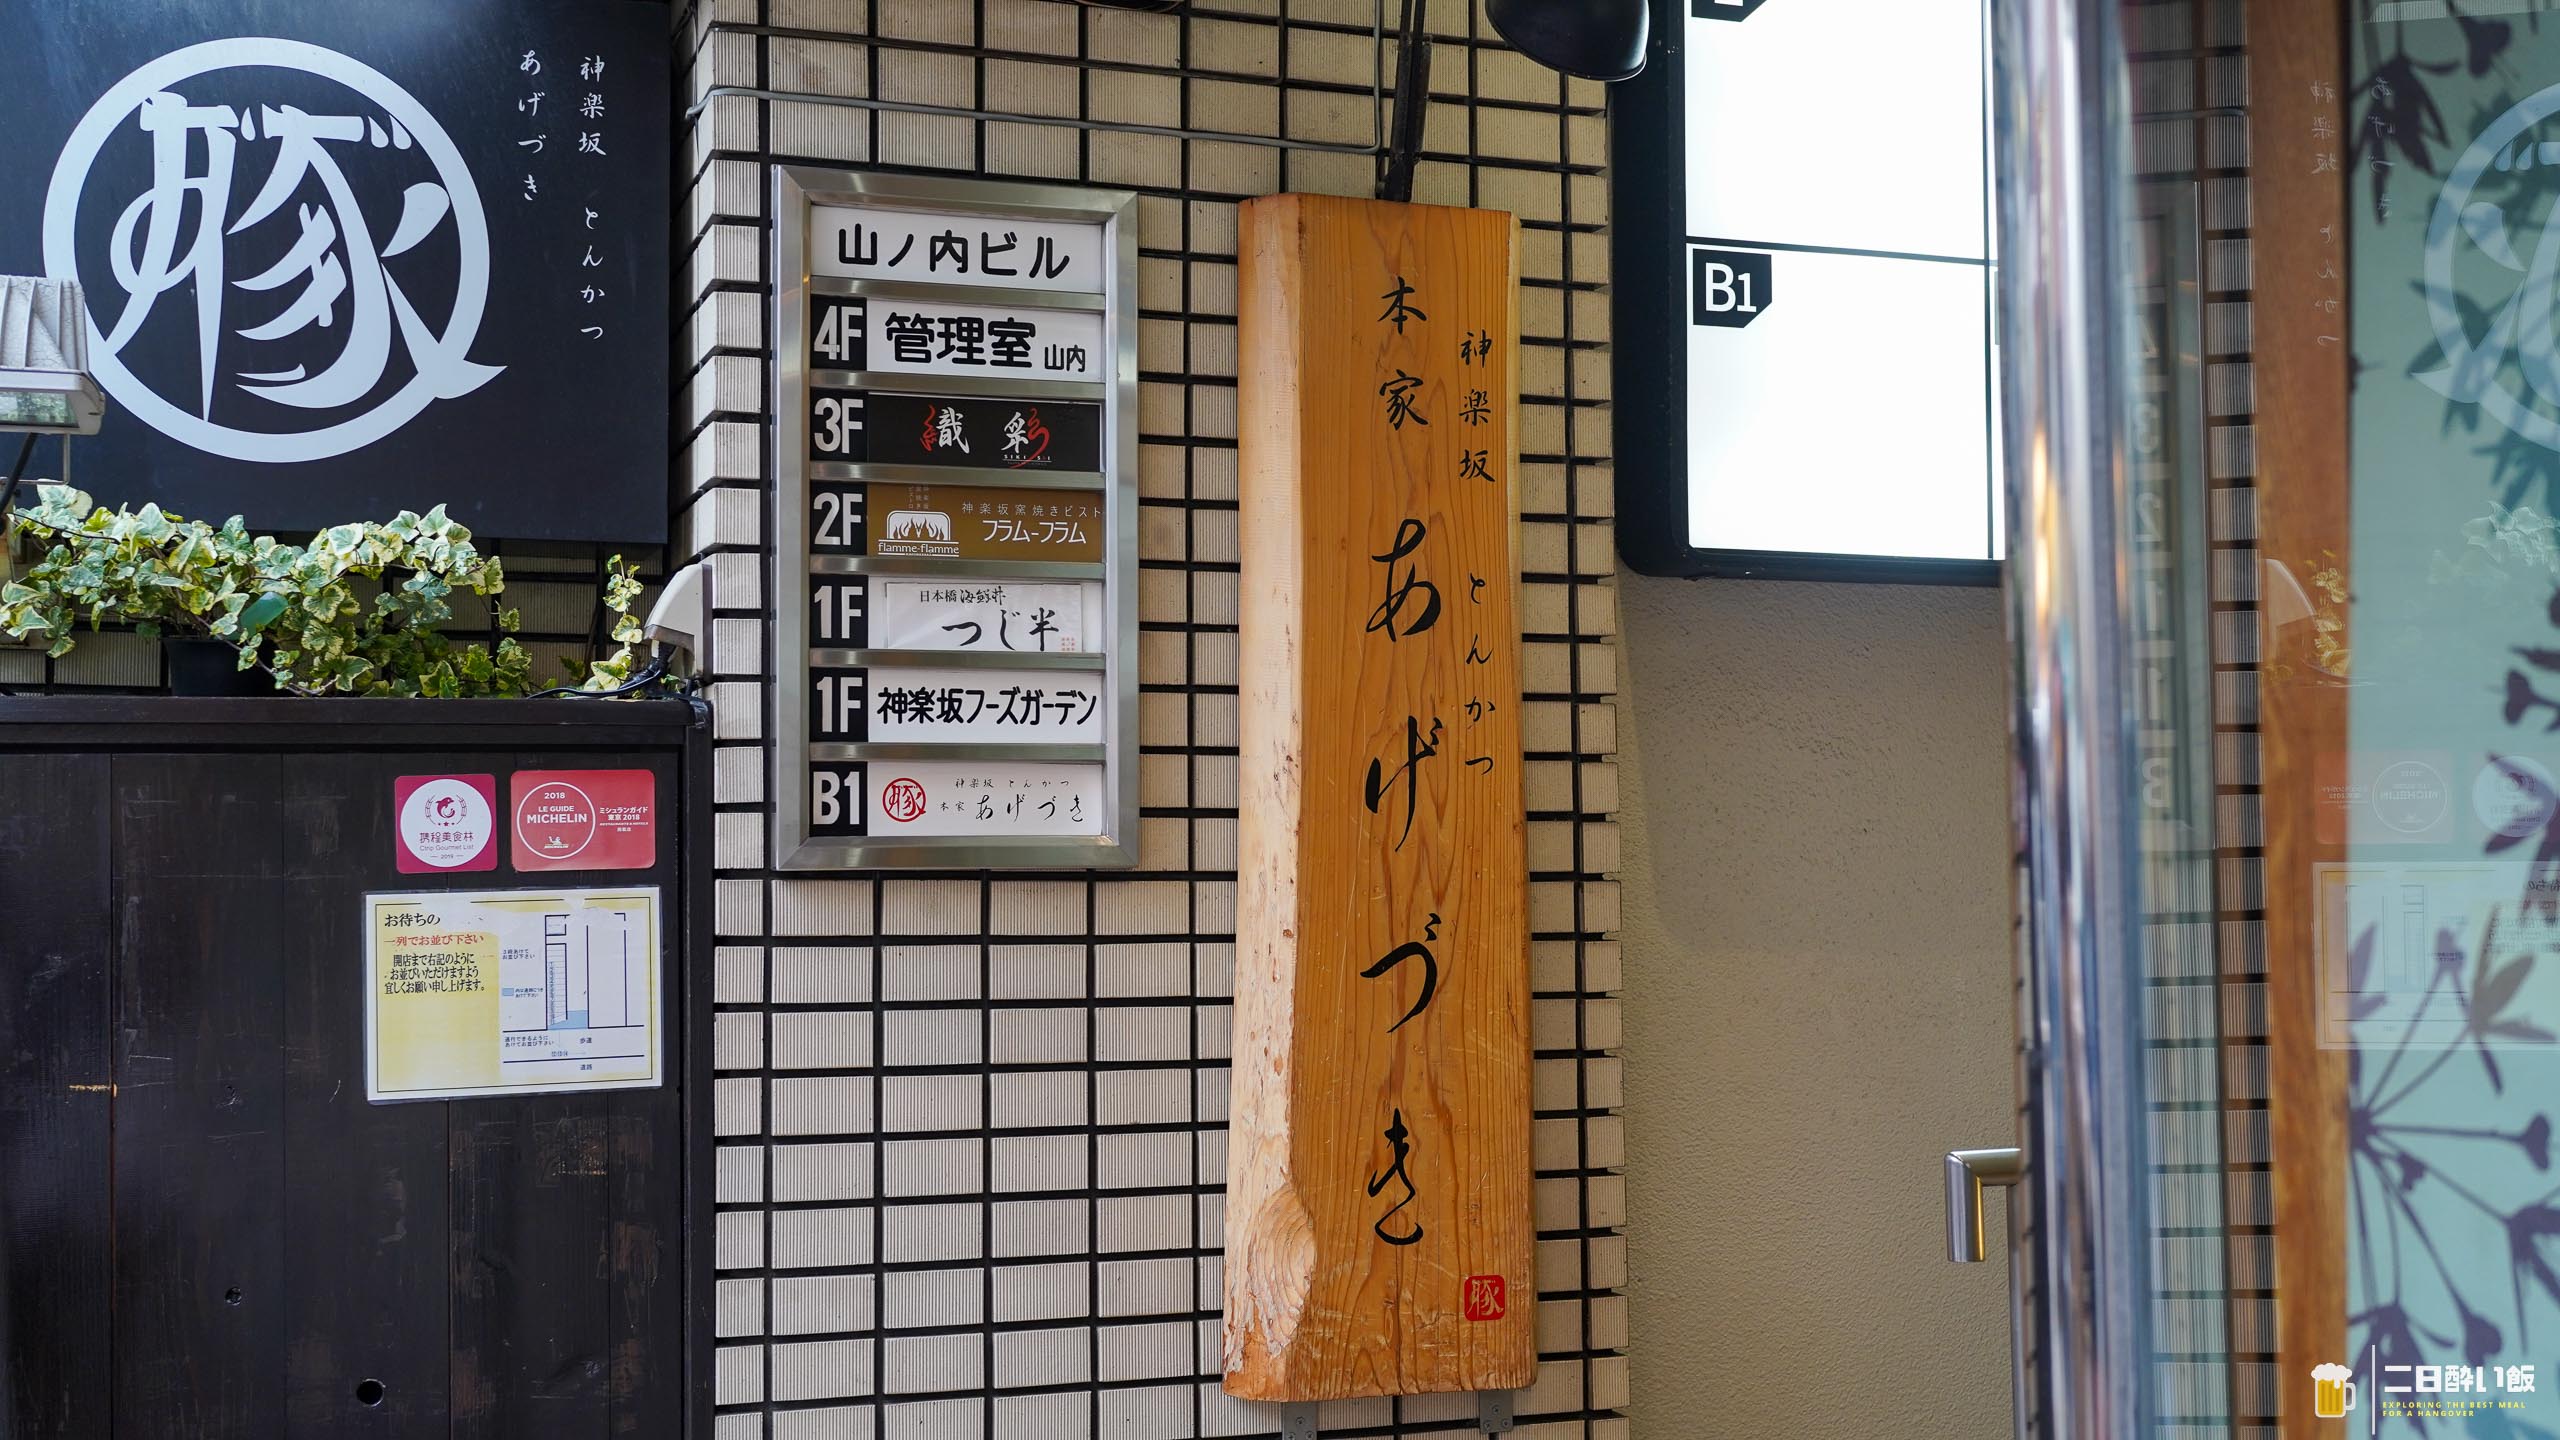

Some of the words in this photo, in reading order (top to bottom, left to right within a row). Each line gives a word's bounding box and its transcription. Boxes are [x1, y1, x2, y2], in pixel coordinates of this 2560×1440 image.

[517, 49, 545, 202] あげづき
[578, 55, 607, 157] 神楽坂
[579, 207, 605, 341] とんかつ
[838, 223, 1071, 280] 山ノ内ビル
[1705, 262, 1758, 313] B1
[813, 305, 864, 361] 4F
[885, 312, 1037, 368] 管理室
[1044, 344, 1087, 373] 山内
[1376, 277, 1429, 432] 本家
[813, 398, 864, 454] 3F
[1458, 331, 1497, 484] 神楽坂
[813, 492, 863, 547] 2F
[961, 501, 1104, 518] 神楽坂窯焼きビスト
[878, 541, 960, 555] flamme-flamme
[813, 585, 863, 640] 1F
[942, 607, 1060, 651] つじ半
[1464, 571, 1497, 776] とんかつ
[816, 677, 863, 733] 1F
[877, 686, 1098, 726] 神楽坂フーズガーデン
[599, 806, 649, 814] ミシュランガイド
[813, 771, 861, 825] B1
[955, 778, 995, 789] 神楽坂
[975, 794, 1084, 823] あげづき
[526, 813, 588, 824] MICHELIN
[1359, 518, 1442, 1247] あげづき
[384, 912, 441, 928] お待ちの
[384, 933, 484, 947] 一列でお並び下さい
[389, 965, 479, 981] お並びいただけますよう
[393, 952, 475, 967] 開店まで右記のように
